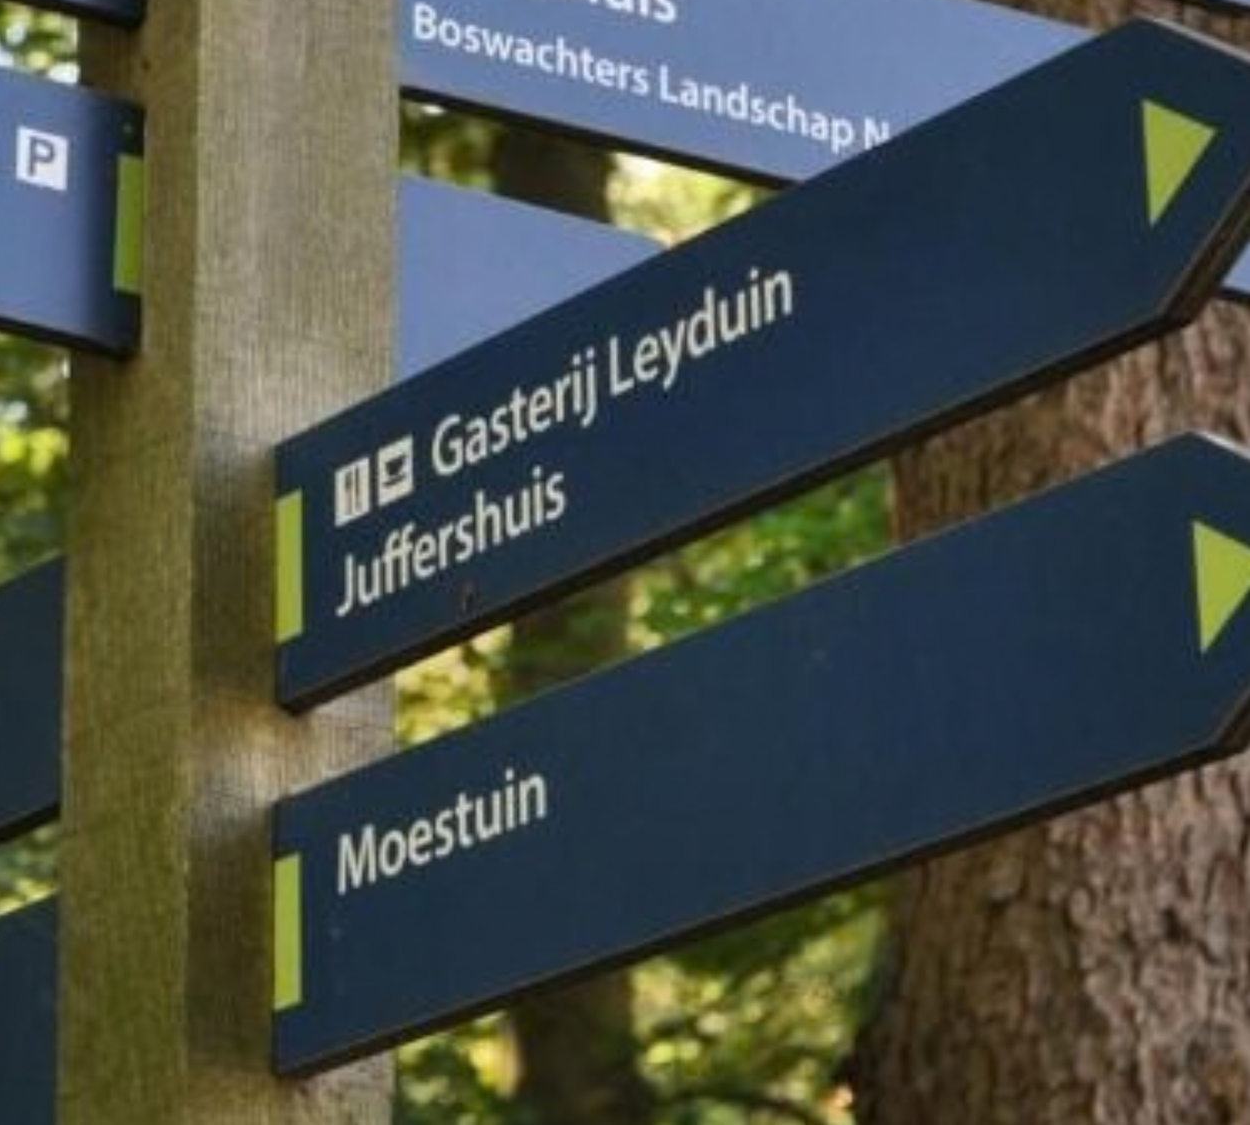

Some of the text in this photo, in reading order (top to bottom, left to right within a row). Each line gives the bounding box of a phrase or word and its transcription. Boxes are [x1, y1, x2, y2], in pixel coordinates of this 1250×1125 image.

[413, 3, 650, 94] Boswachters
[659, 65, 855, 154] Landschap
[430, 270, 793, 477] Gasterij Leyduin
[335, 467, 567, 618] Juffershuis
[336, 768, 547, 895] Moestuin
